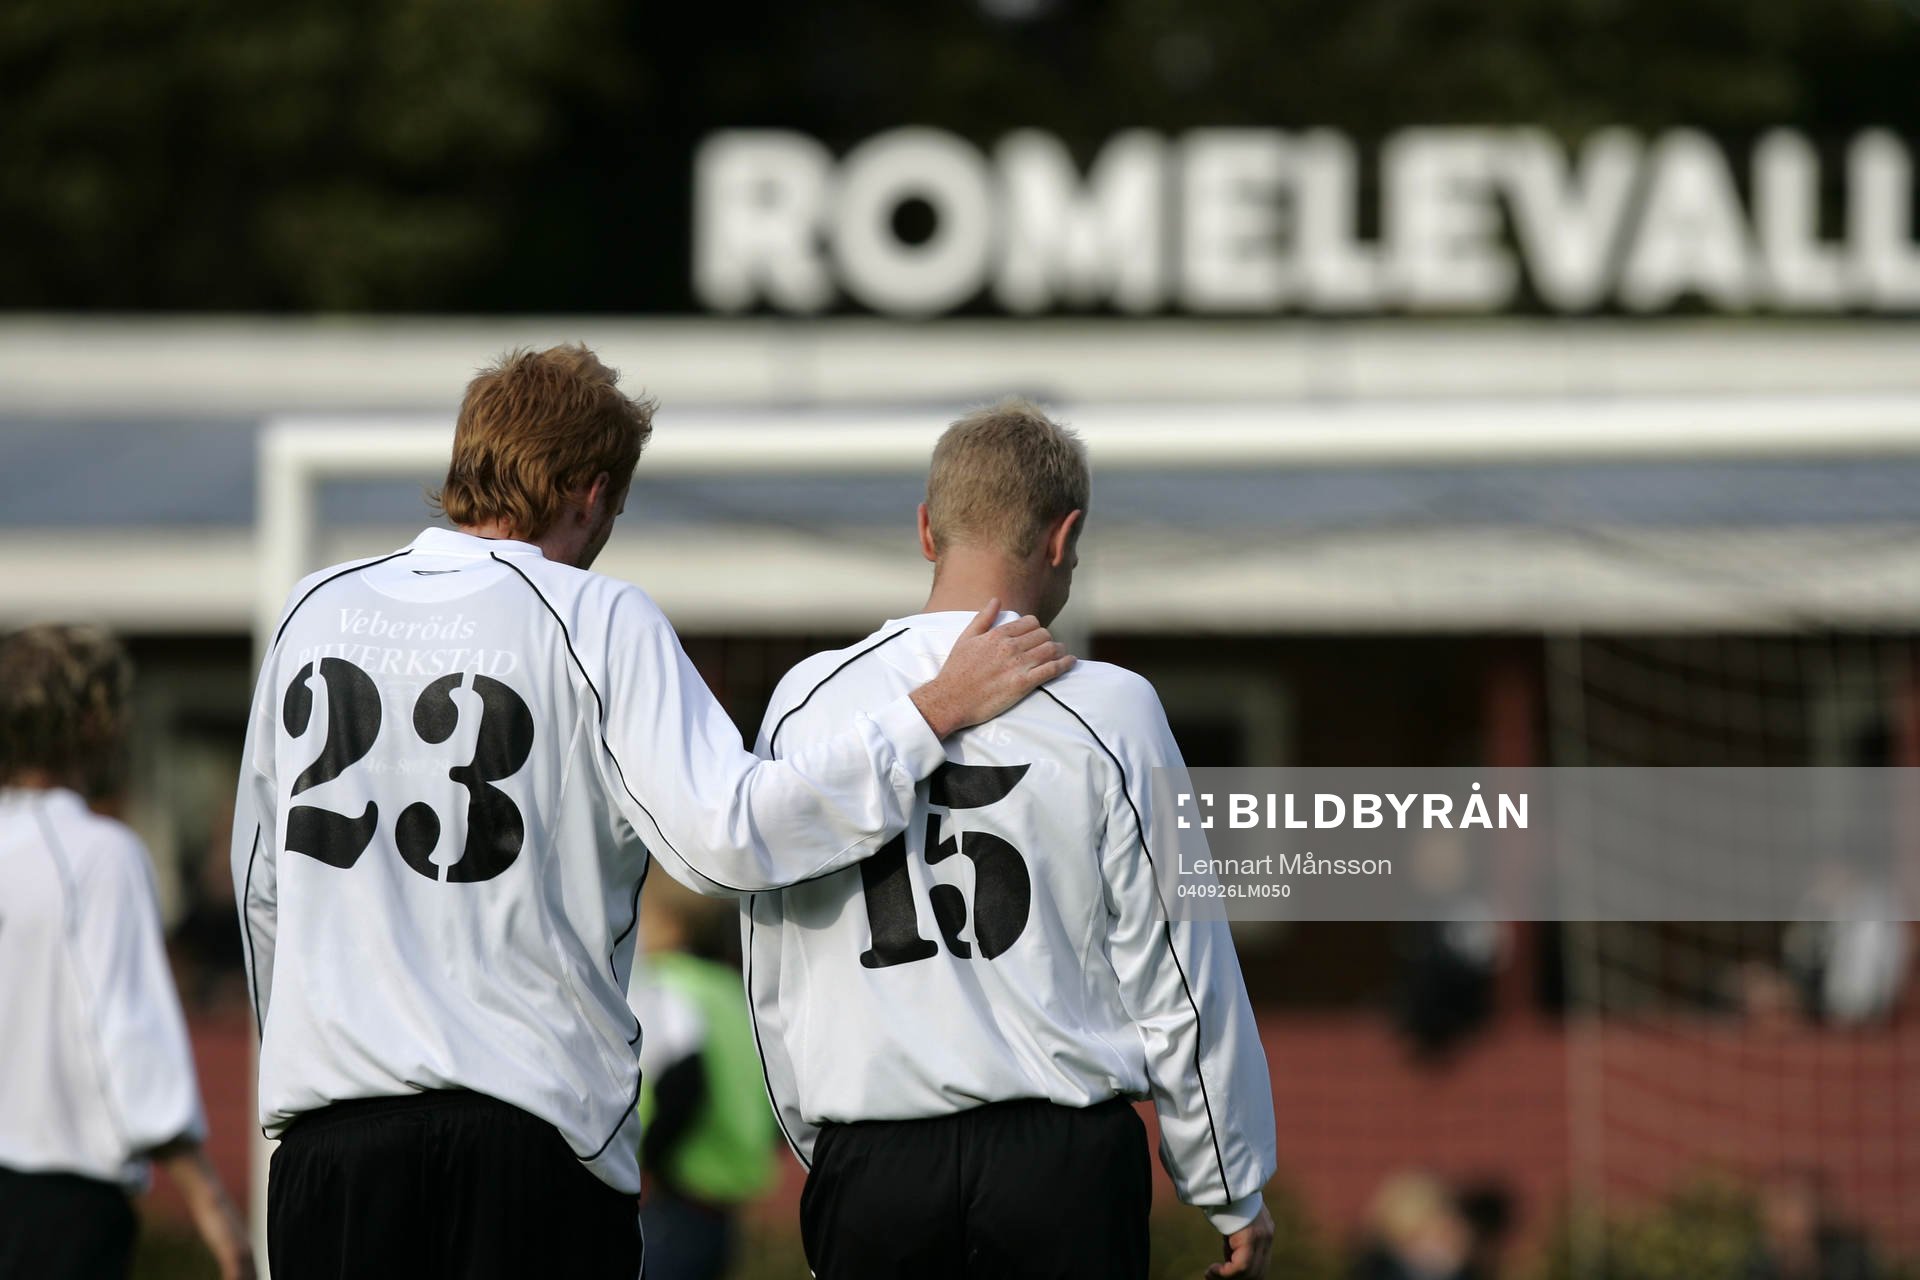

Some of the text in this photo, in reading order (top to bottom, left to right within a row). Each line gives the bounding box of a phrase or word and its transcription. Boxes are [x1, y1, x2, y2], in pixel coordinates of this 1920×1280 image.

[337, 608, 477, 640] Veberöds
[283, 656, 534, 882] 23
[860, 761, 1032, 969] 15
